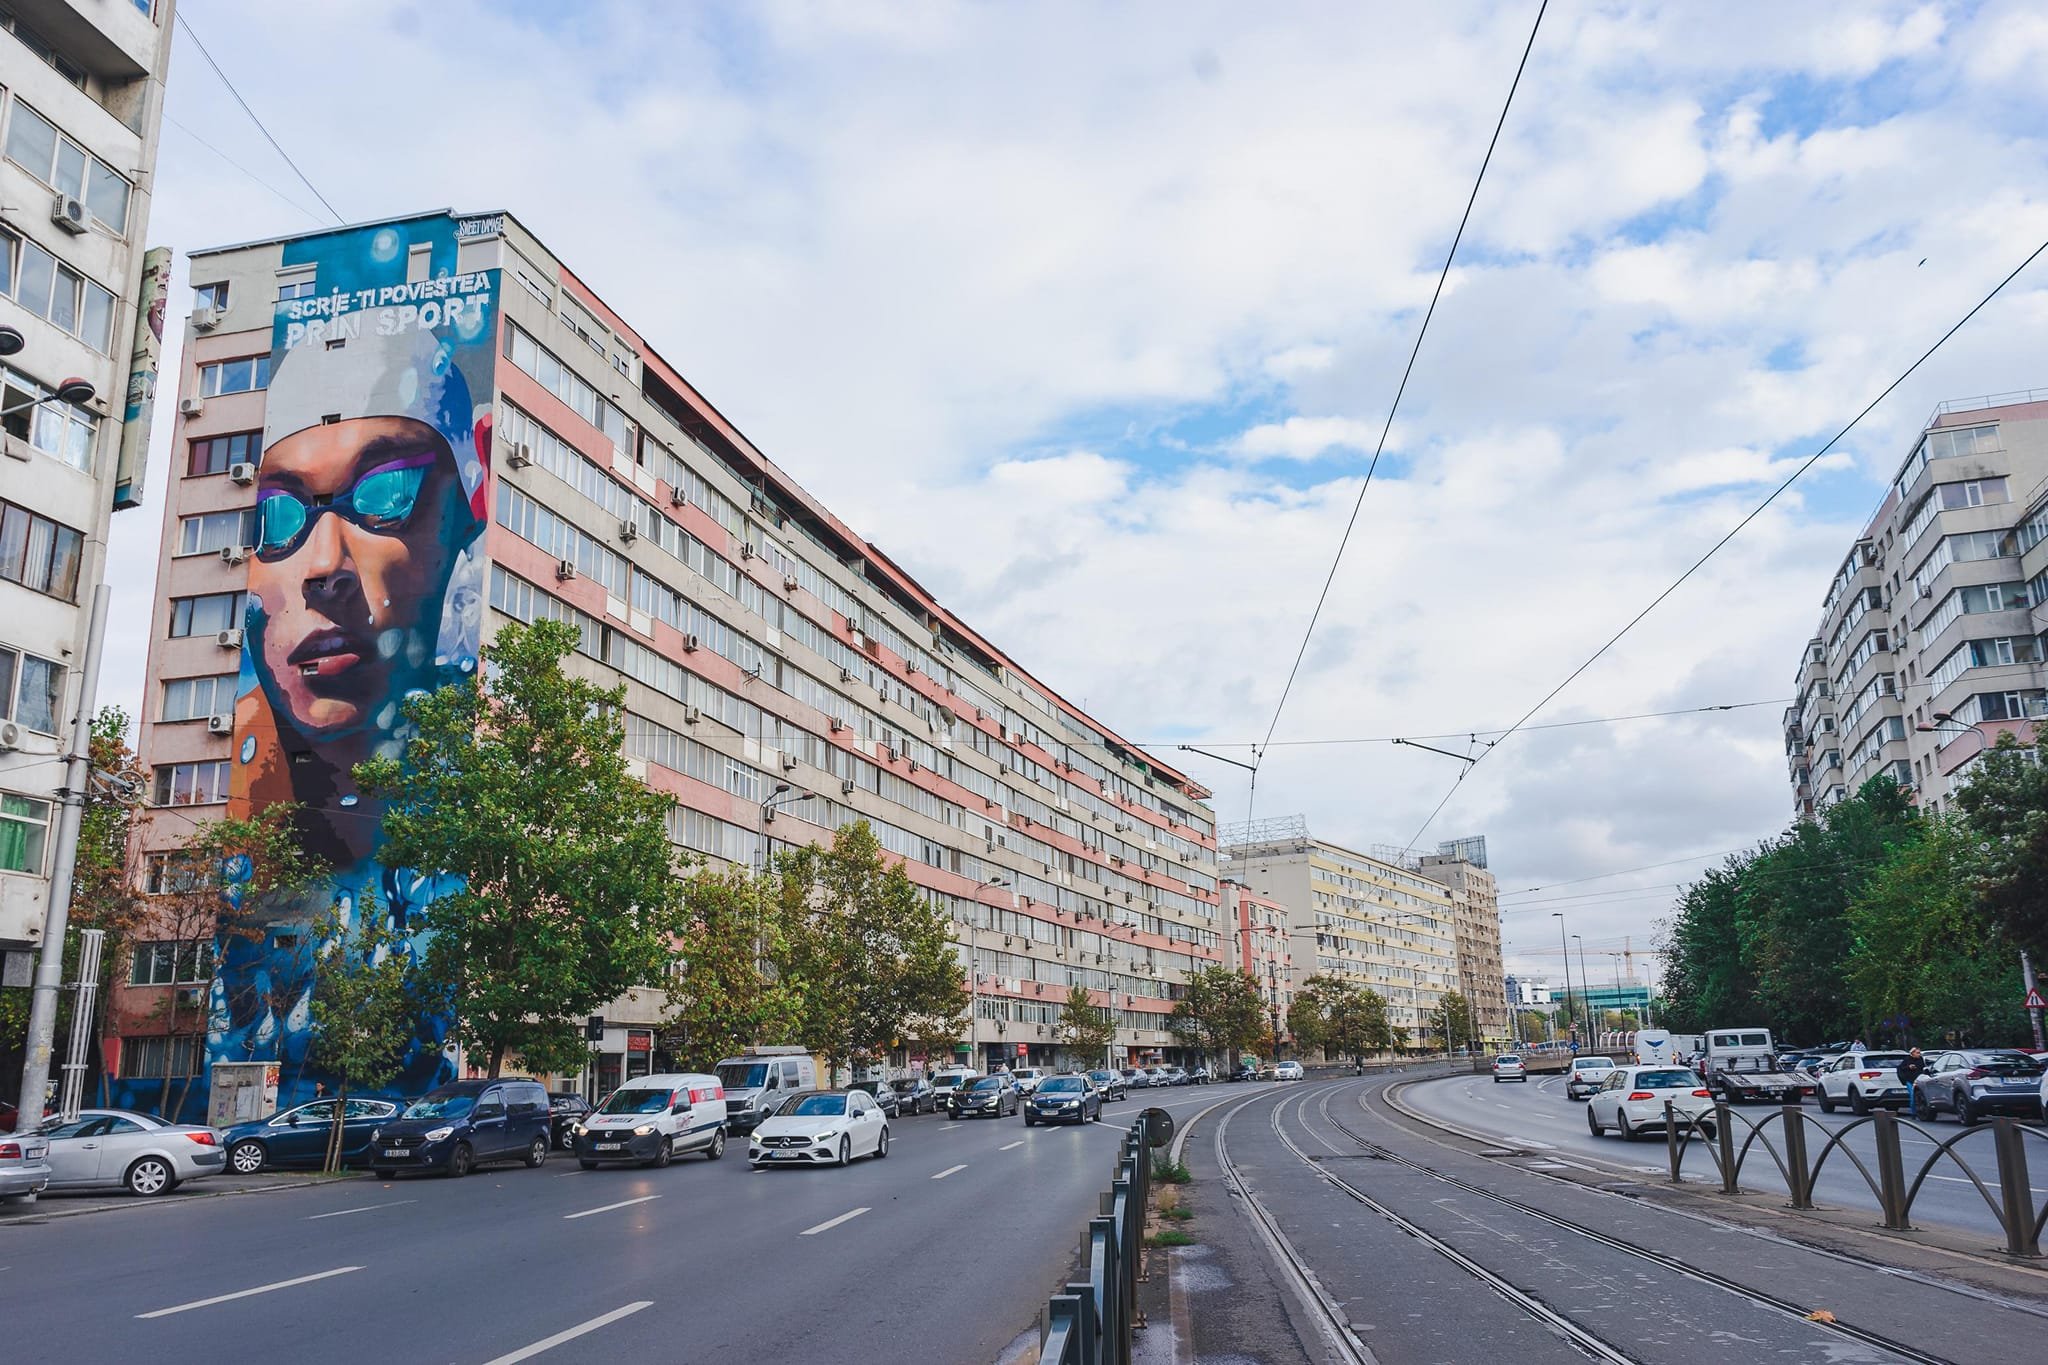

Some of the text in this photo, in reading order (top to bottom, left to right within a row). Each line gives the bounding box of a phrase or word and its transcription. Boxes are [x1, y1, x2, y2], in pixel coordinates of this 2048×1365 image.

[378, 272, 491, 306] POVESTEA
[285, 293, 490, 350] PRIN SPORT
